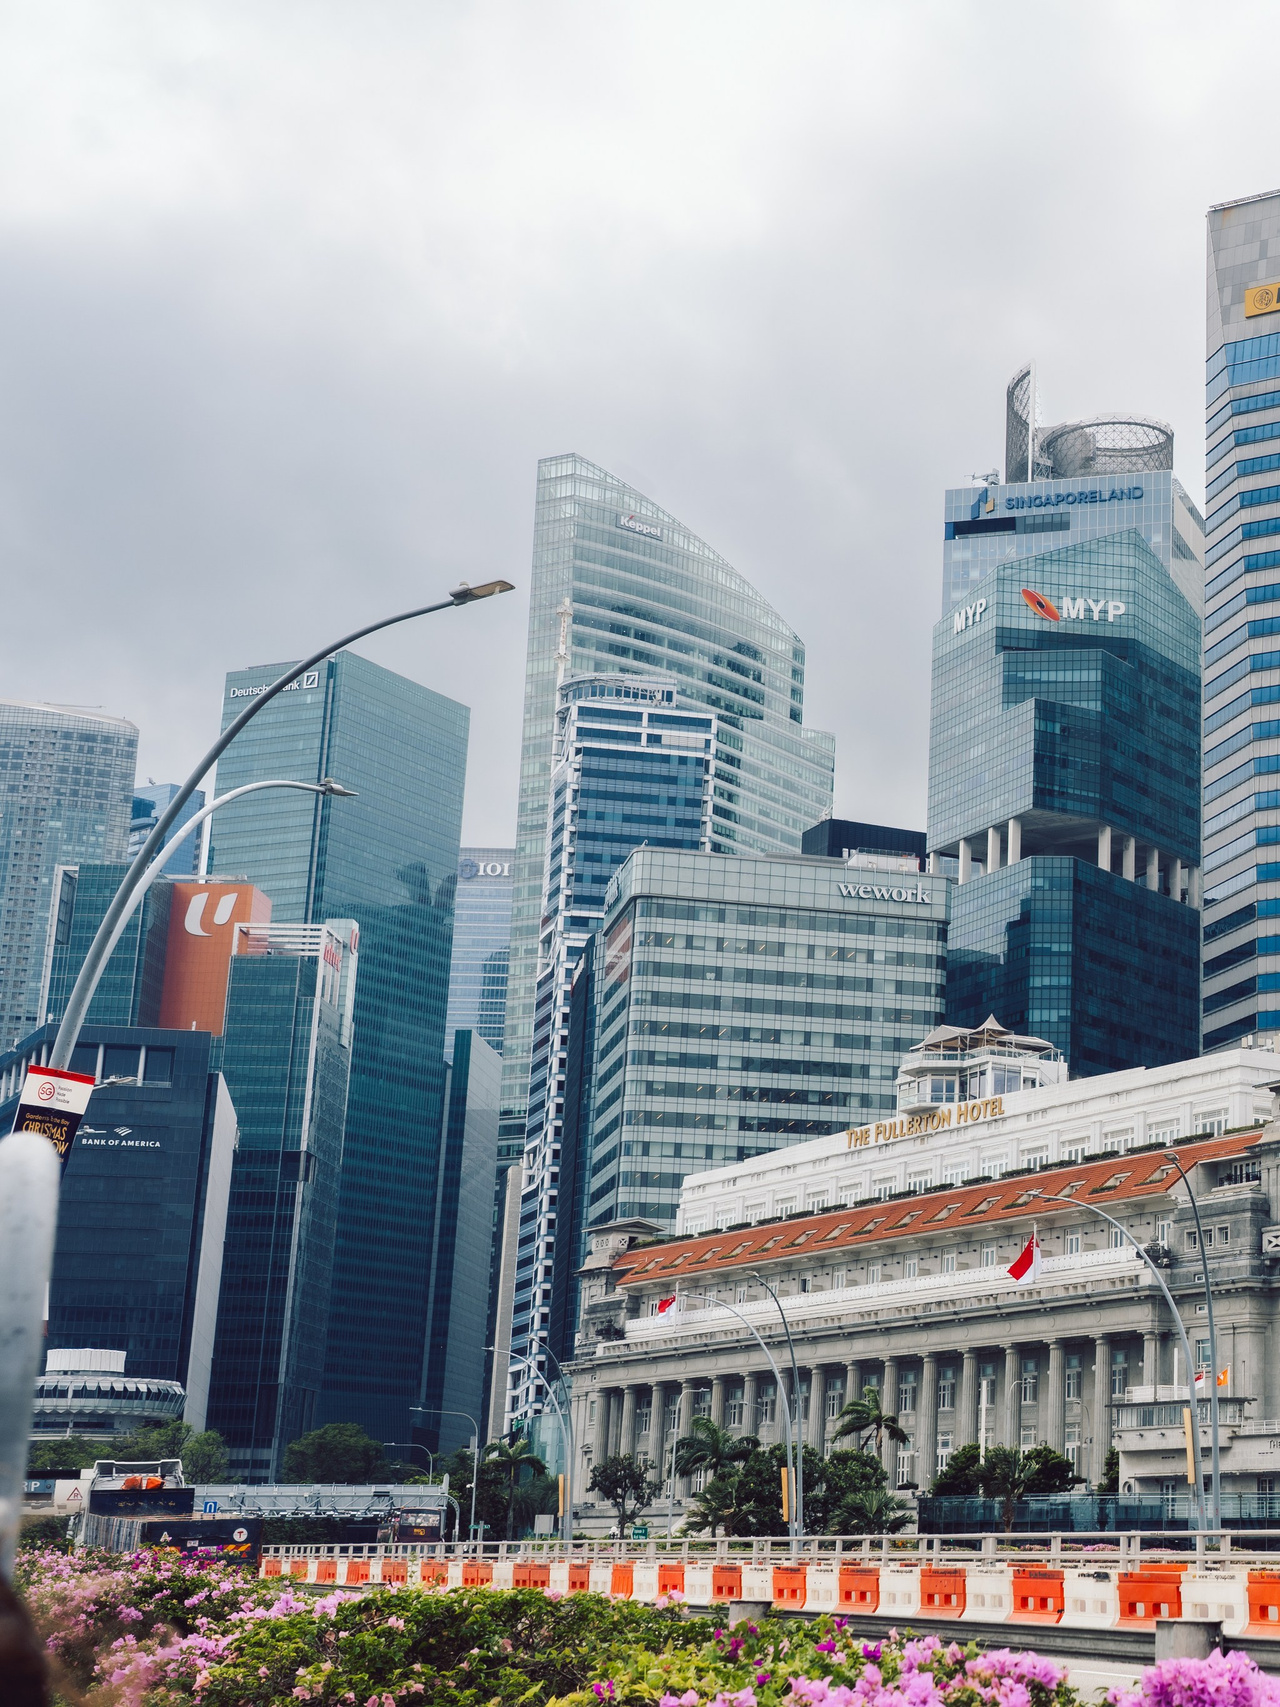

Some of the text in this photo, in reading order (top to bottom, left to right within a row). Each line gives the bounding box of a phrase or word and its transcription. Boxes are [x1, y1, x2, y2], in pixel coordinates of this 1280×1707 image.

[1005, 486, 1144, 510] SINGAPORELAND
[620, 515, 661, 537] Keppel
[953, 598, 987, 635] MYP
[1062, 596, 1126, 623] MYP
[230, 684, 274, 698] Deutsch
[477, 862, 511, 877] IOI
[838, 882, 932, 904] wework
[39, 1086, 53, 1096] SG
[846, 1096, 1005, 1149] THE FULLERTON HOTEL
[81, 1138, 106, 1146] BANK
[120, 1140, 161, 1148] AMERICA
